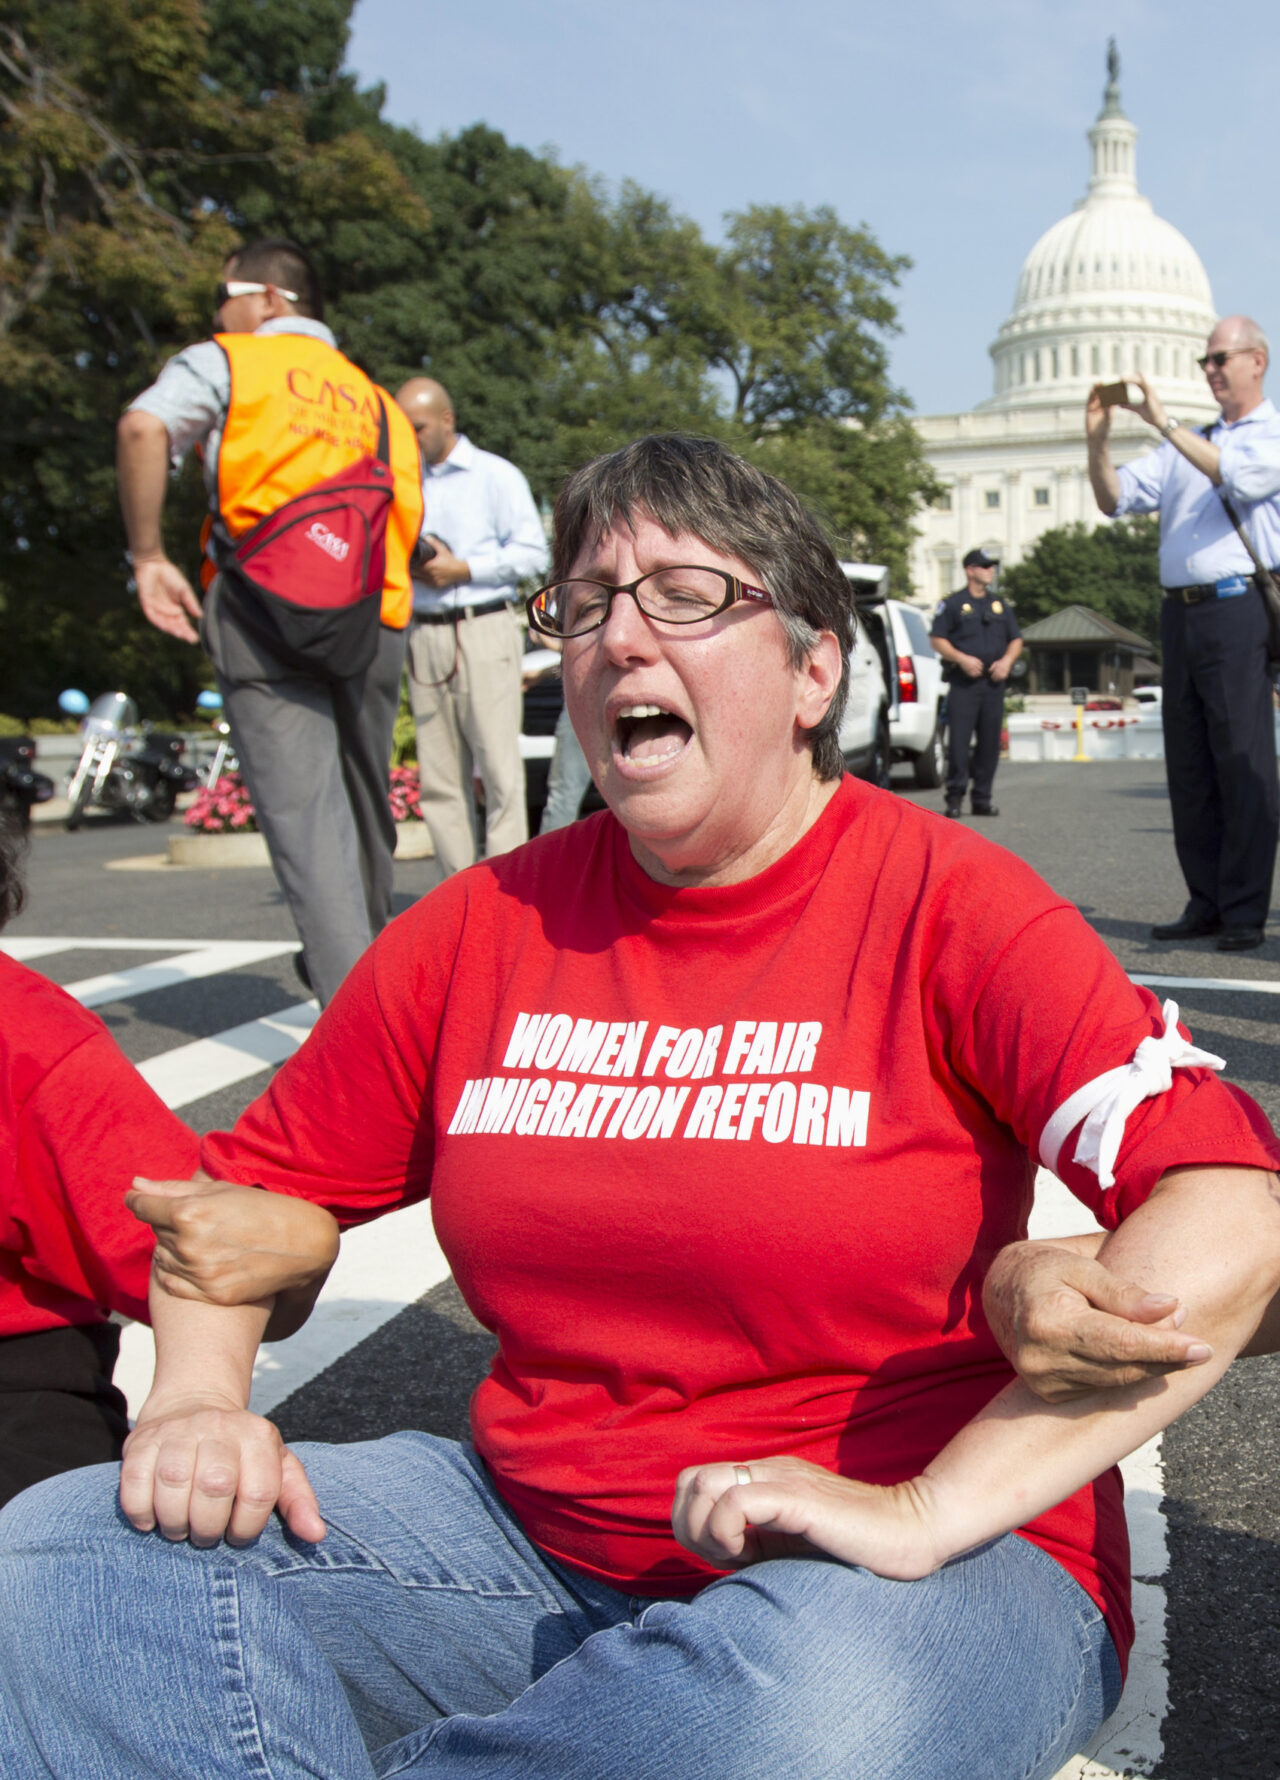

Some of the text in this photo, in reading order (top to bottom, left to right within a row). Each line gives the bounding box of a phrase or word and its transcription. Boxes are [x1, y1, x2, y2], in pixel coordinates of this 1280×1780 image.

[286, 367, 379, 428] CASA
[310, 522, 350, 561] CASA
[502, 1012, 823, 1079] WOMEN FOR FAIR
[446, 1077, 871, 1147] IMMIGRATION REFORM
